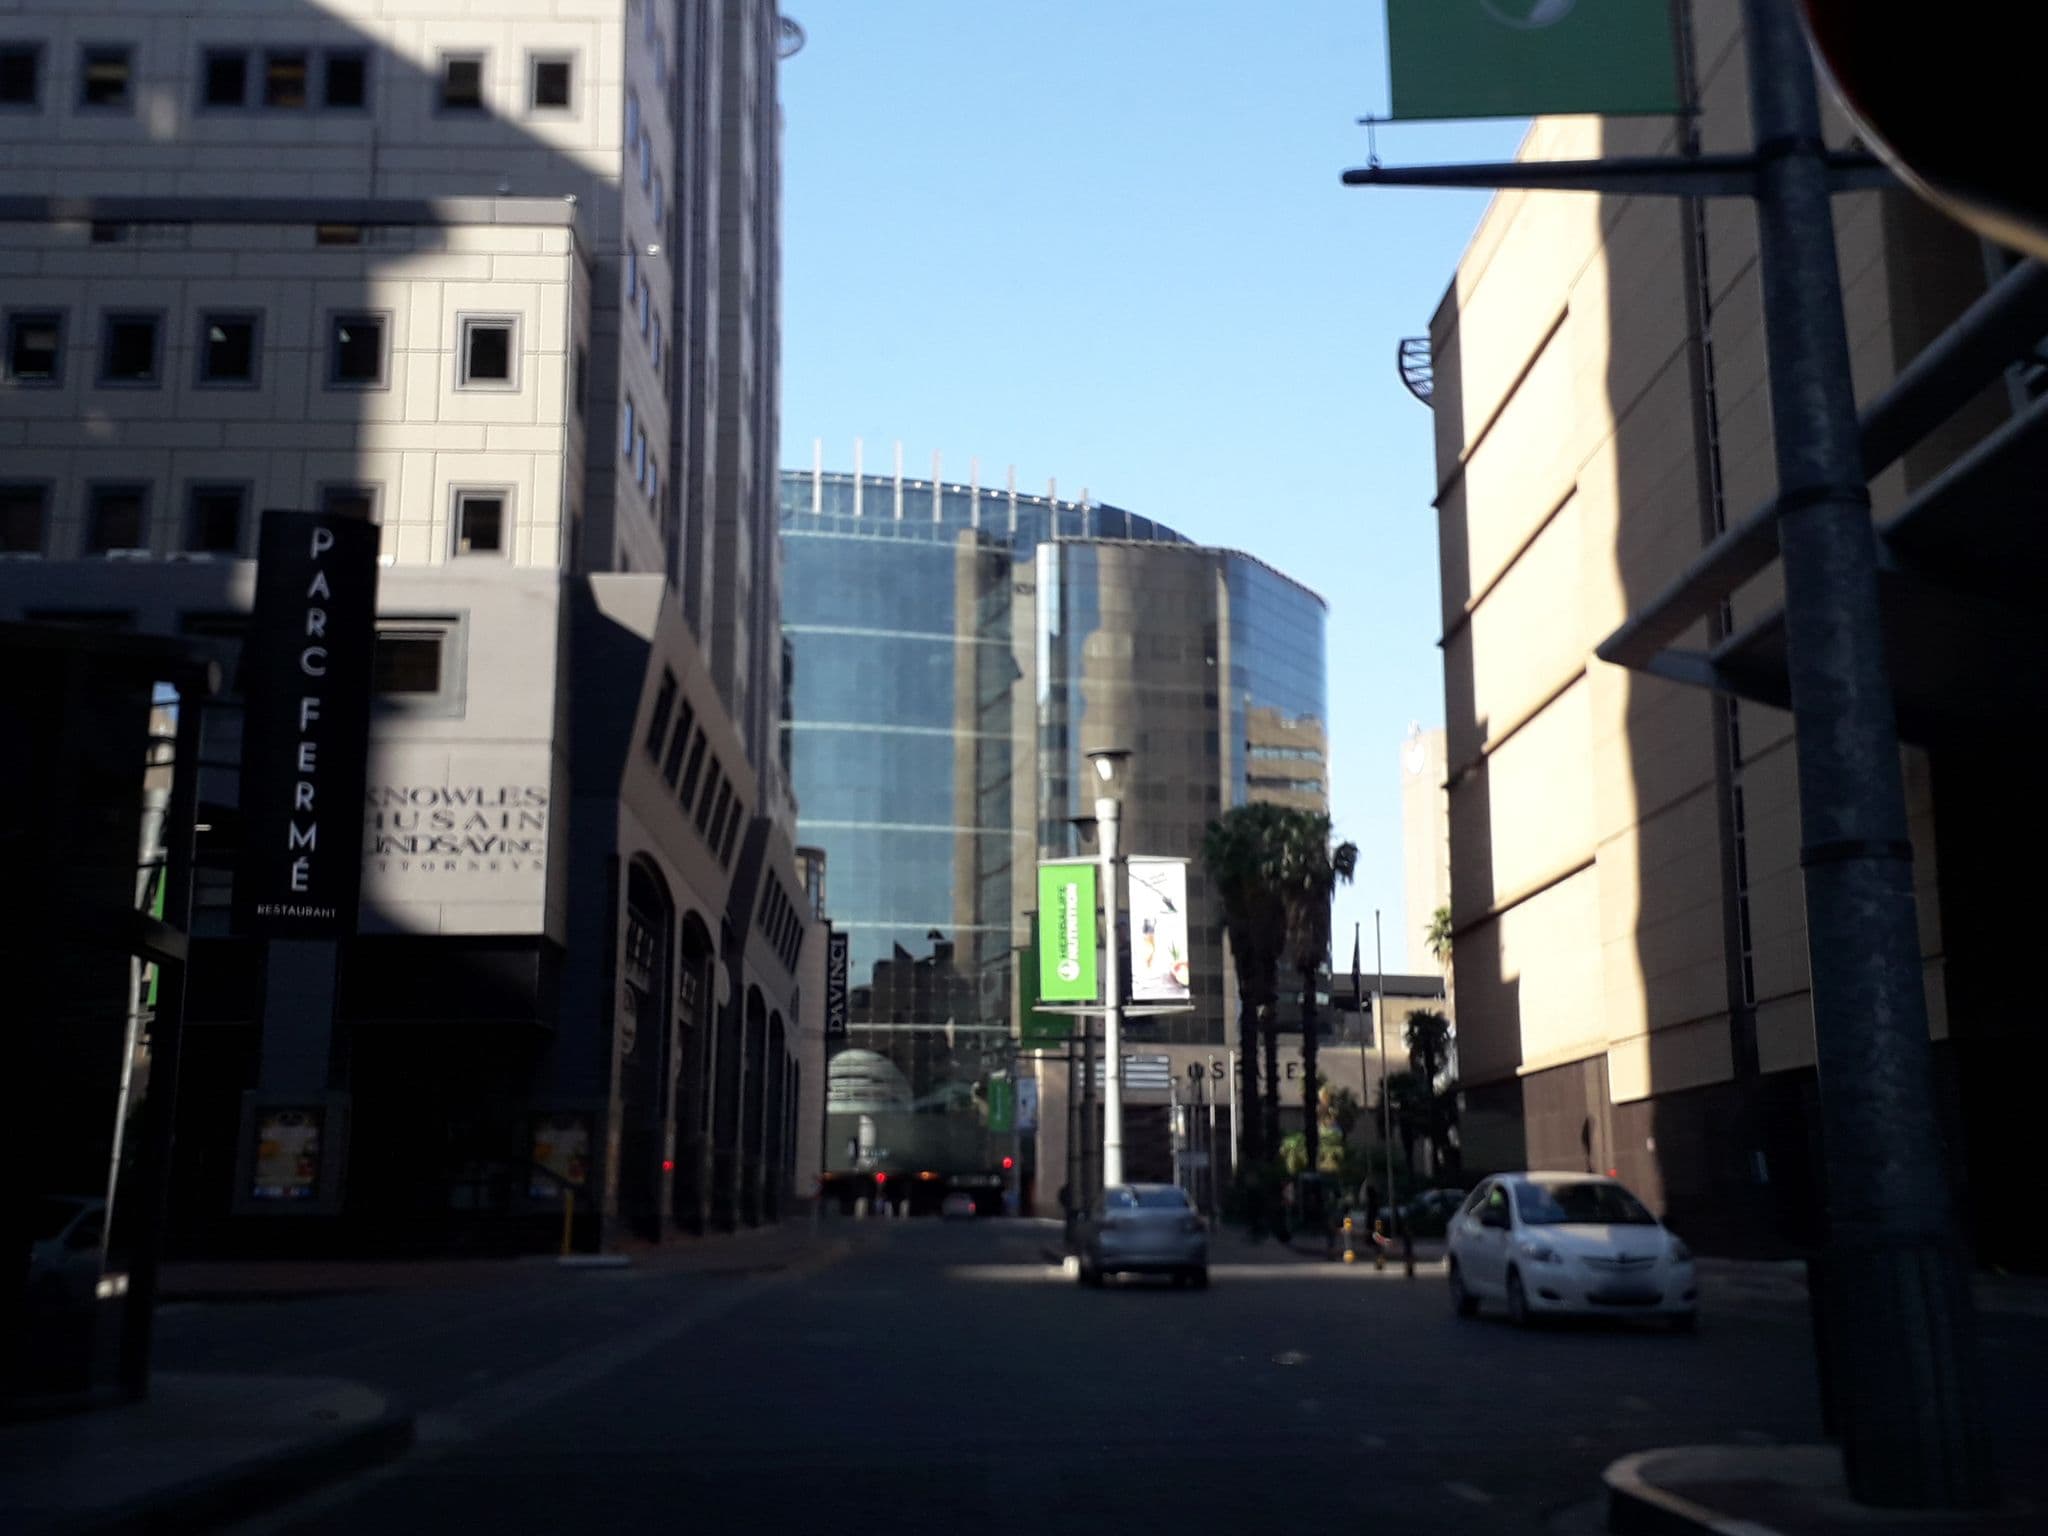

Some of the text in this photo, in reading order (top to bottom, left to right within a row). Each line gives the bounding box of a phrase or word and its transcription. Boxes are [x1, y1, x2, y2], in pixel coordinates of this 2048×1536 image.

[288, 526, 335, 892] PARC FERMÉ
[256, 903, 336, 919] RESTAURANT
